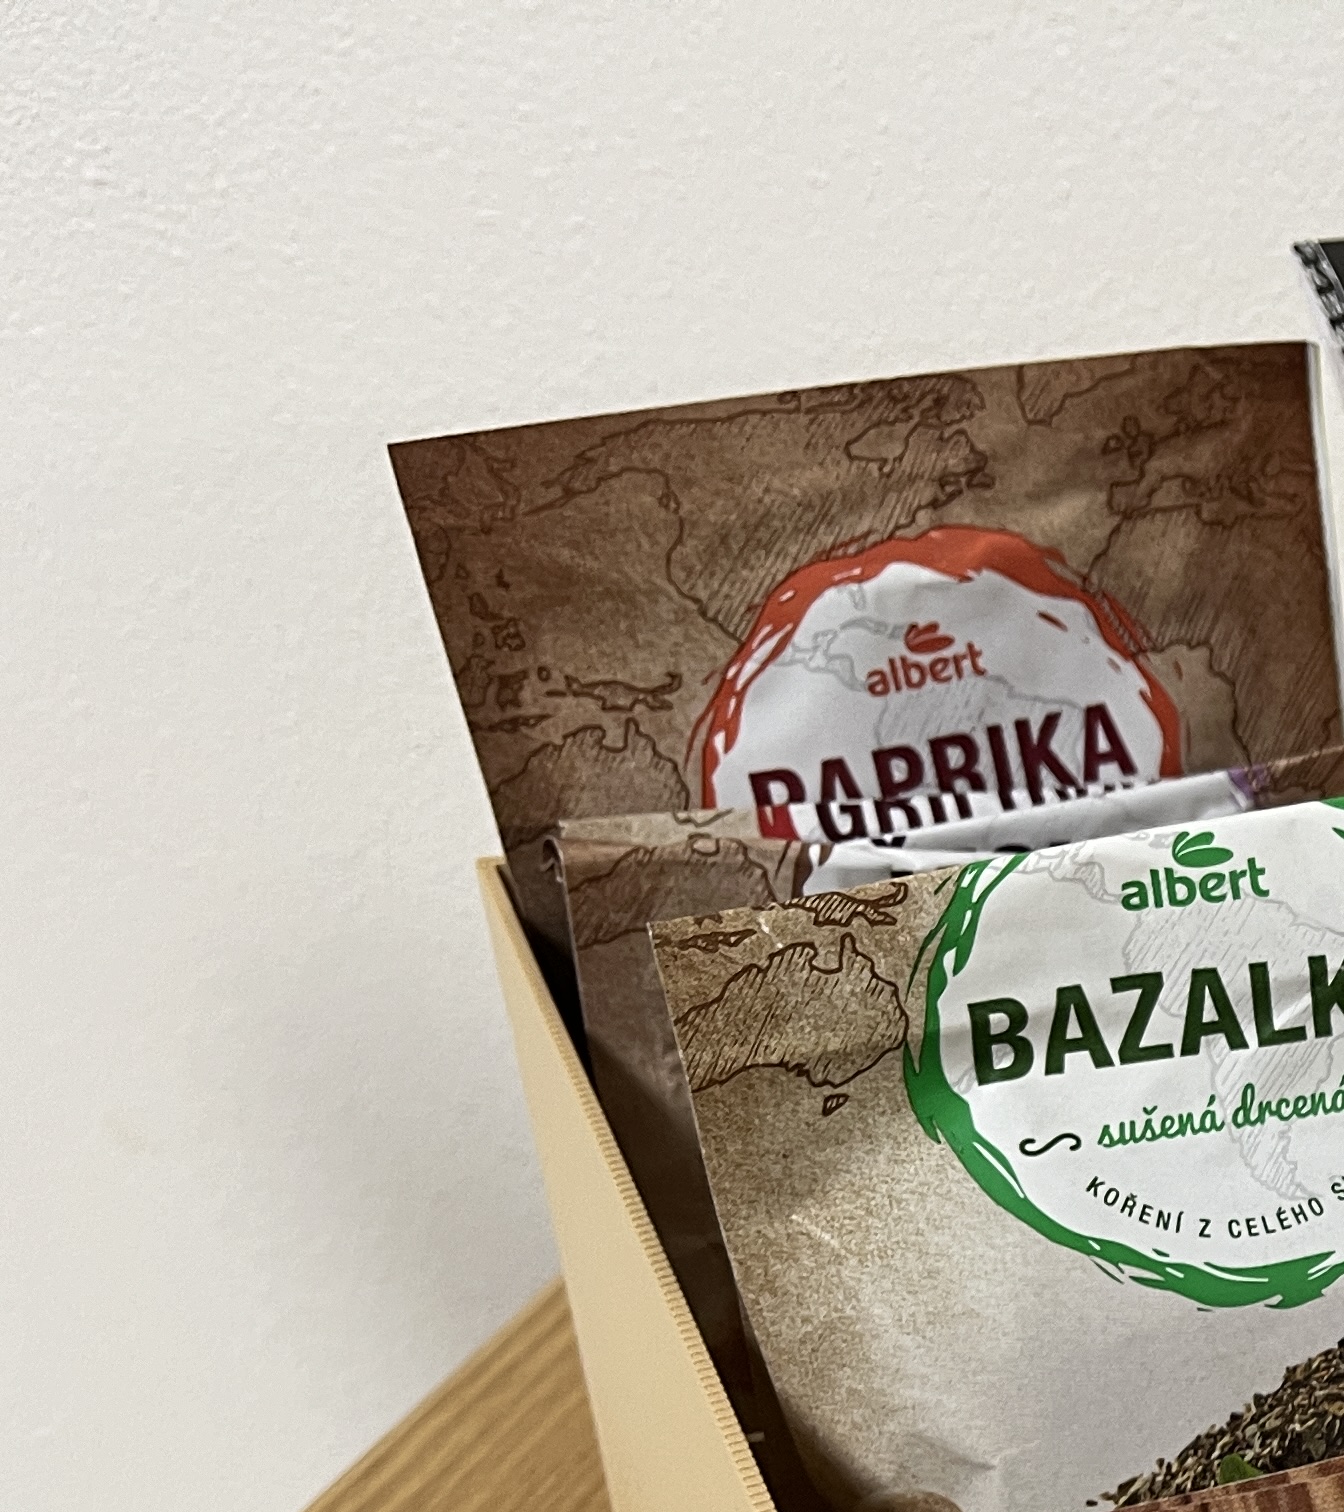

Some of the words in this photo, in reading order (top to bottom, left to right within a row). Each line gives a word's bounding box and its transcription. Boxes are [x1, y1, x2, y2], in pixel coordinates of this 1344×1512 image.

[866, 643, 987, 696] albert
[1121, 855, 1270, 911] albert
[1098, 1094, 1224, 1148] sušená
[1085, 1175, 1185, 1234] KOŘENÍ
[1199, 1218, 1211, 1238] Z
[1228, 1197, 1324, 1239] CELÉHO
